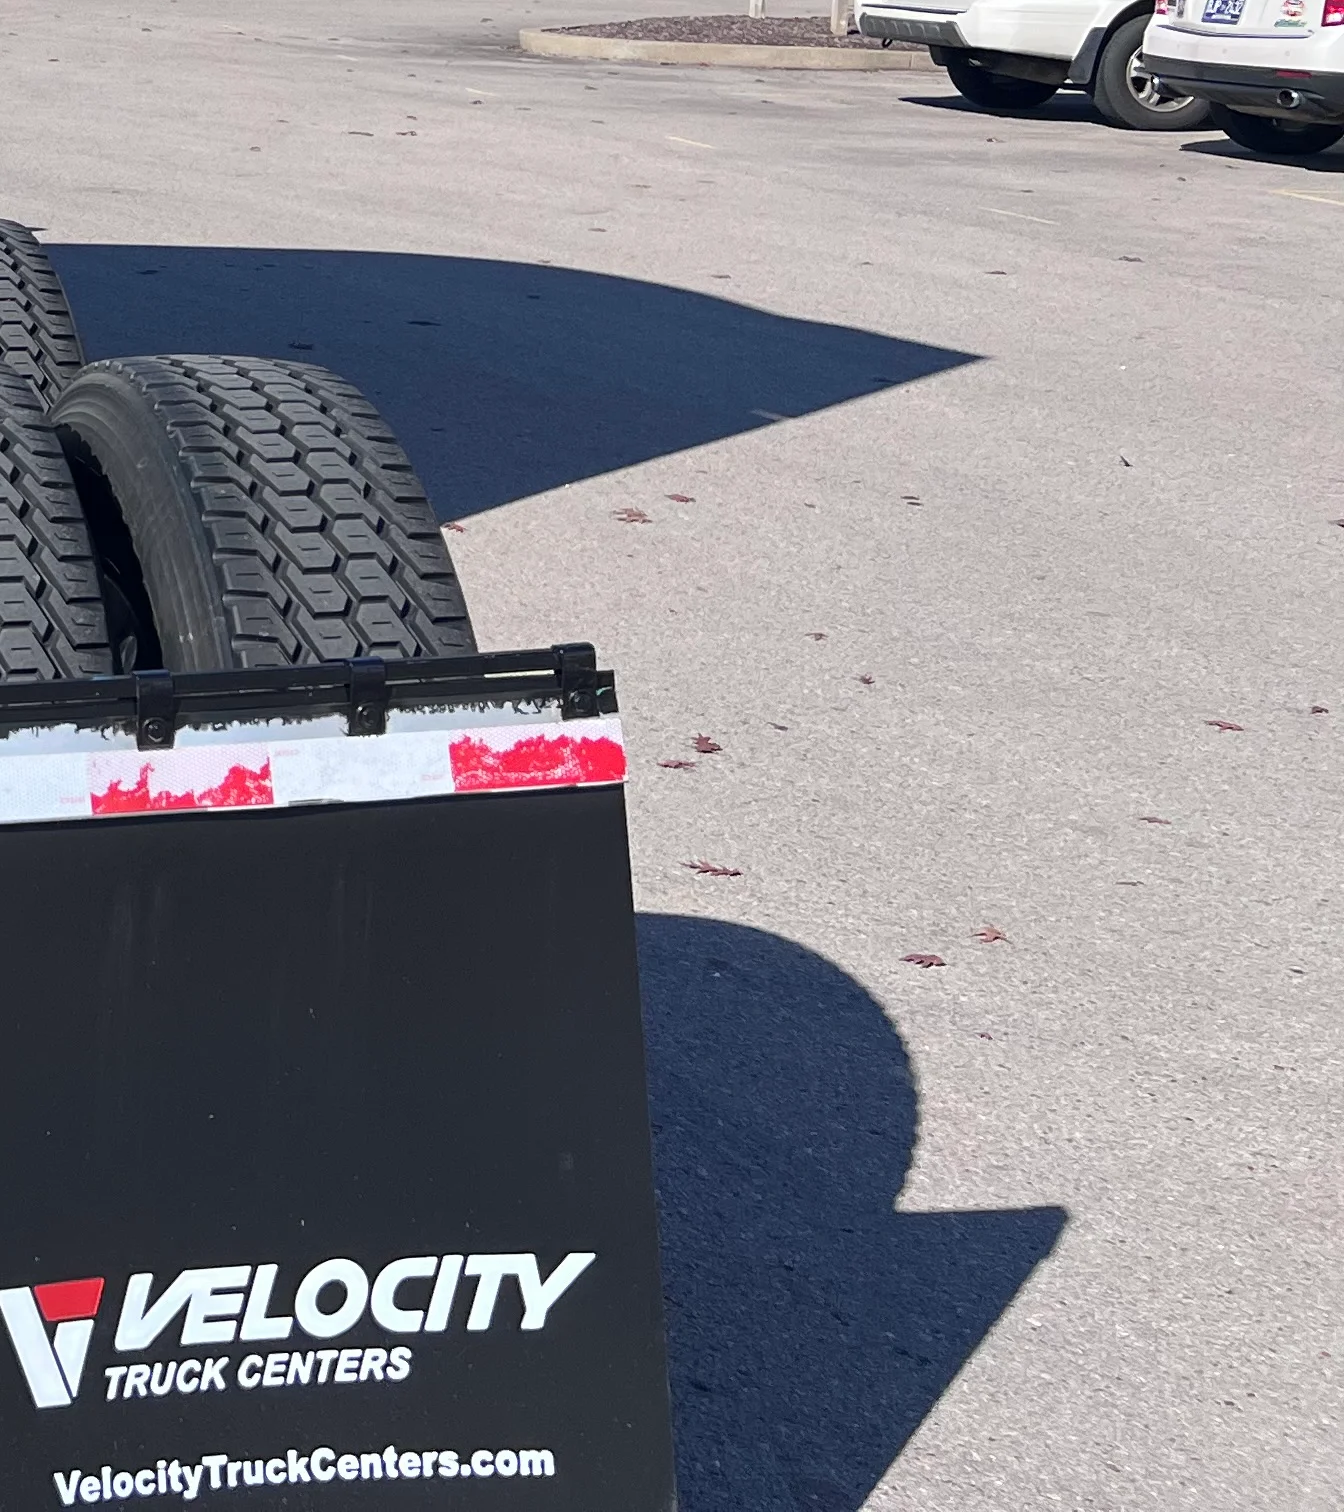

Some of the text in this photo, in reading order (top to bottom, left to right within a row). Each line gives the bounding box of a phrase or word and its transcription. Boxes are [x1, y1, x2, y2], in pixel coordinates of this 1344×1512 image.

[114, 1252, 596, 1352] VELOCITY
[104, 1346, 412, 1400] TRUCK CENTERS
[53, 1445, 556, 1505] VelocityTruckCenters.com
